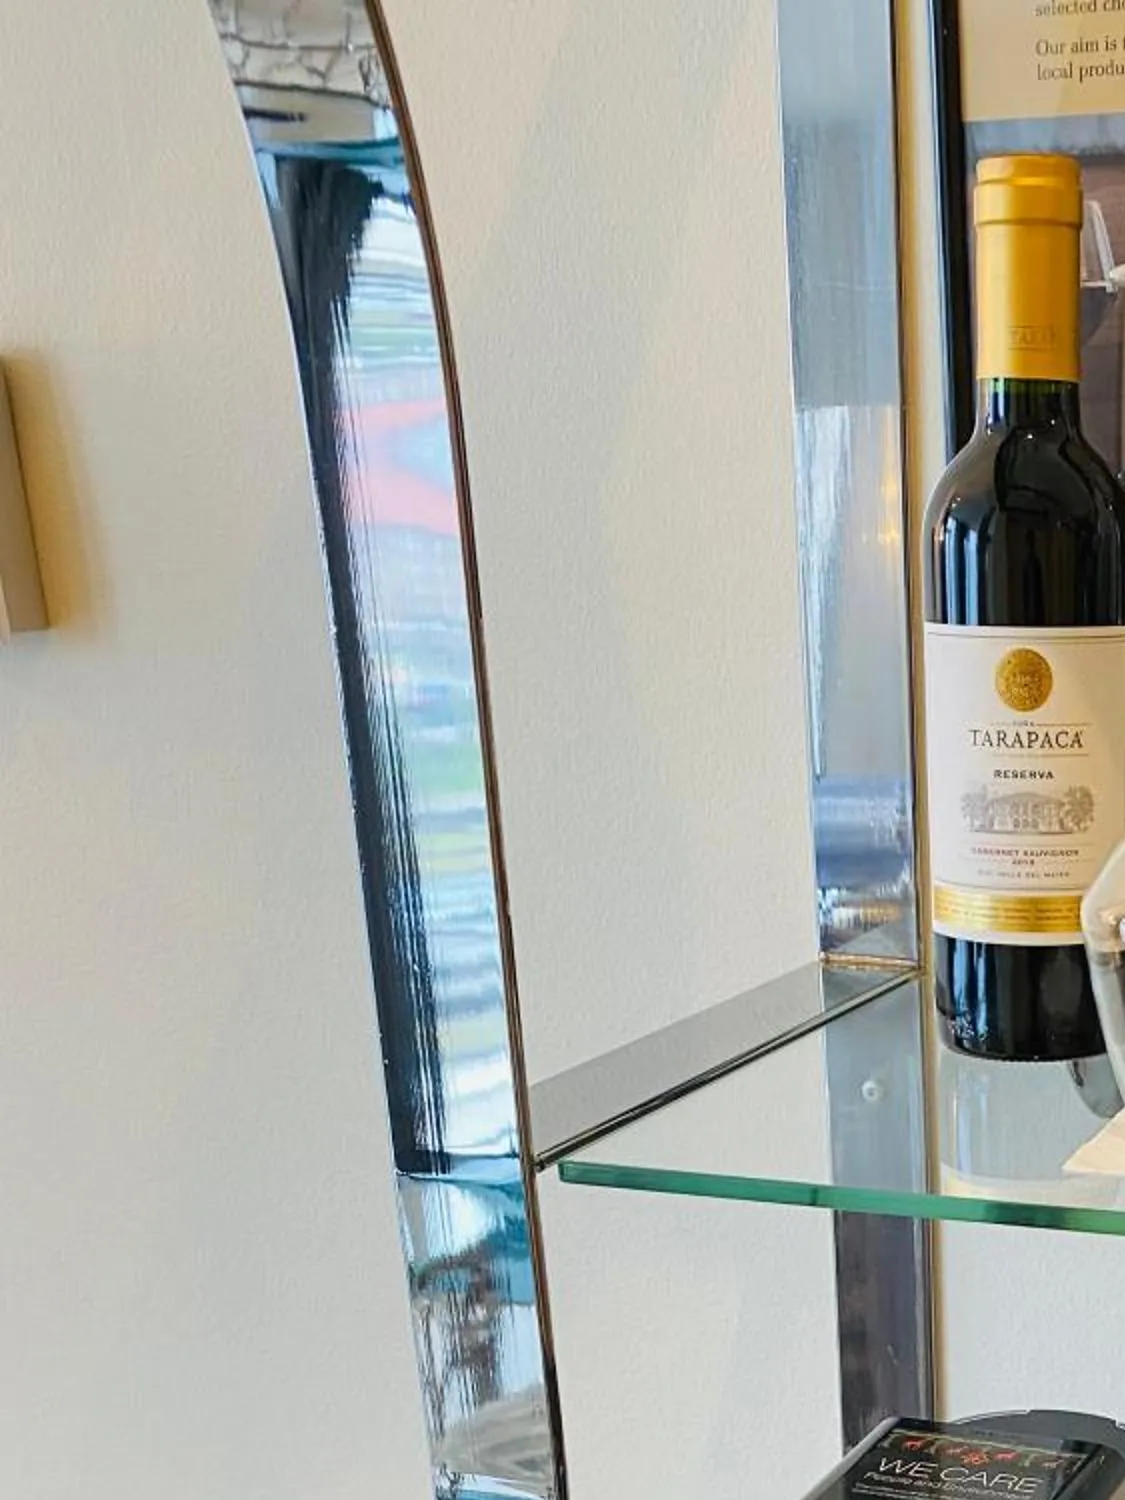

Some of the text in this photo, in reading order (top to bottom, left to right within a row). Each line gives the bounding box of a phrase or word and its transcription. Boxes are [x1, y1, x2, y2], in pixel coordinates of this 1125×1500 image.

[1035, 39, 1065, 56] Our
[1071, 37, 1099, 53] aim
[1104, 35, 1117, 52] is
[1036, 62, 1073, 81] local
[993, 769, 1055, 780] RESERVA
[879, 1458, 1045, 1494] WE CARE
